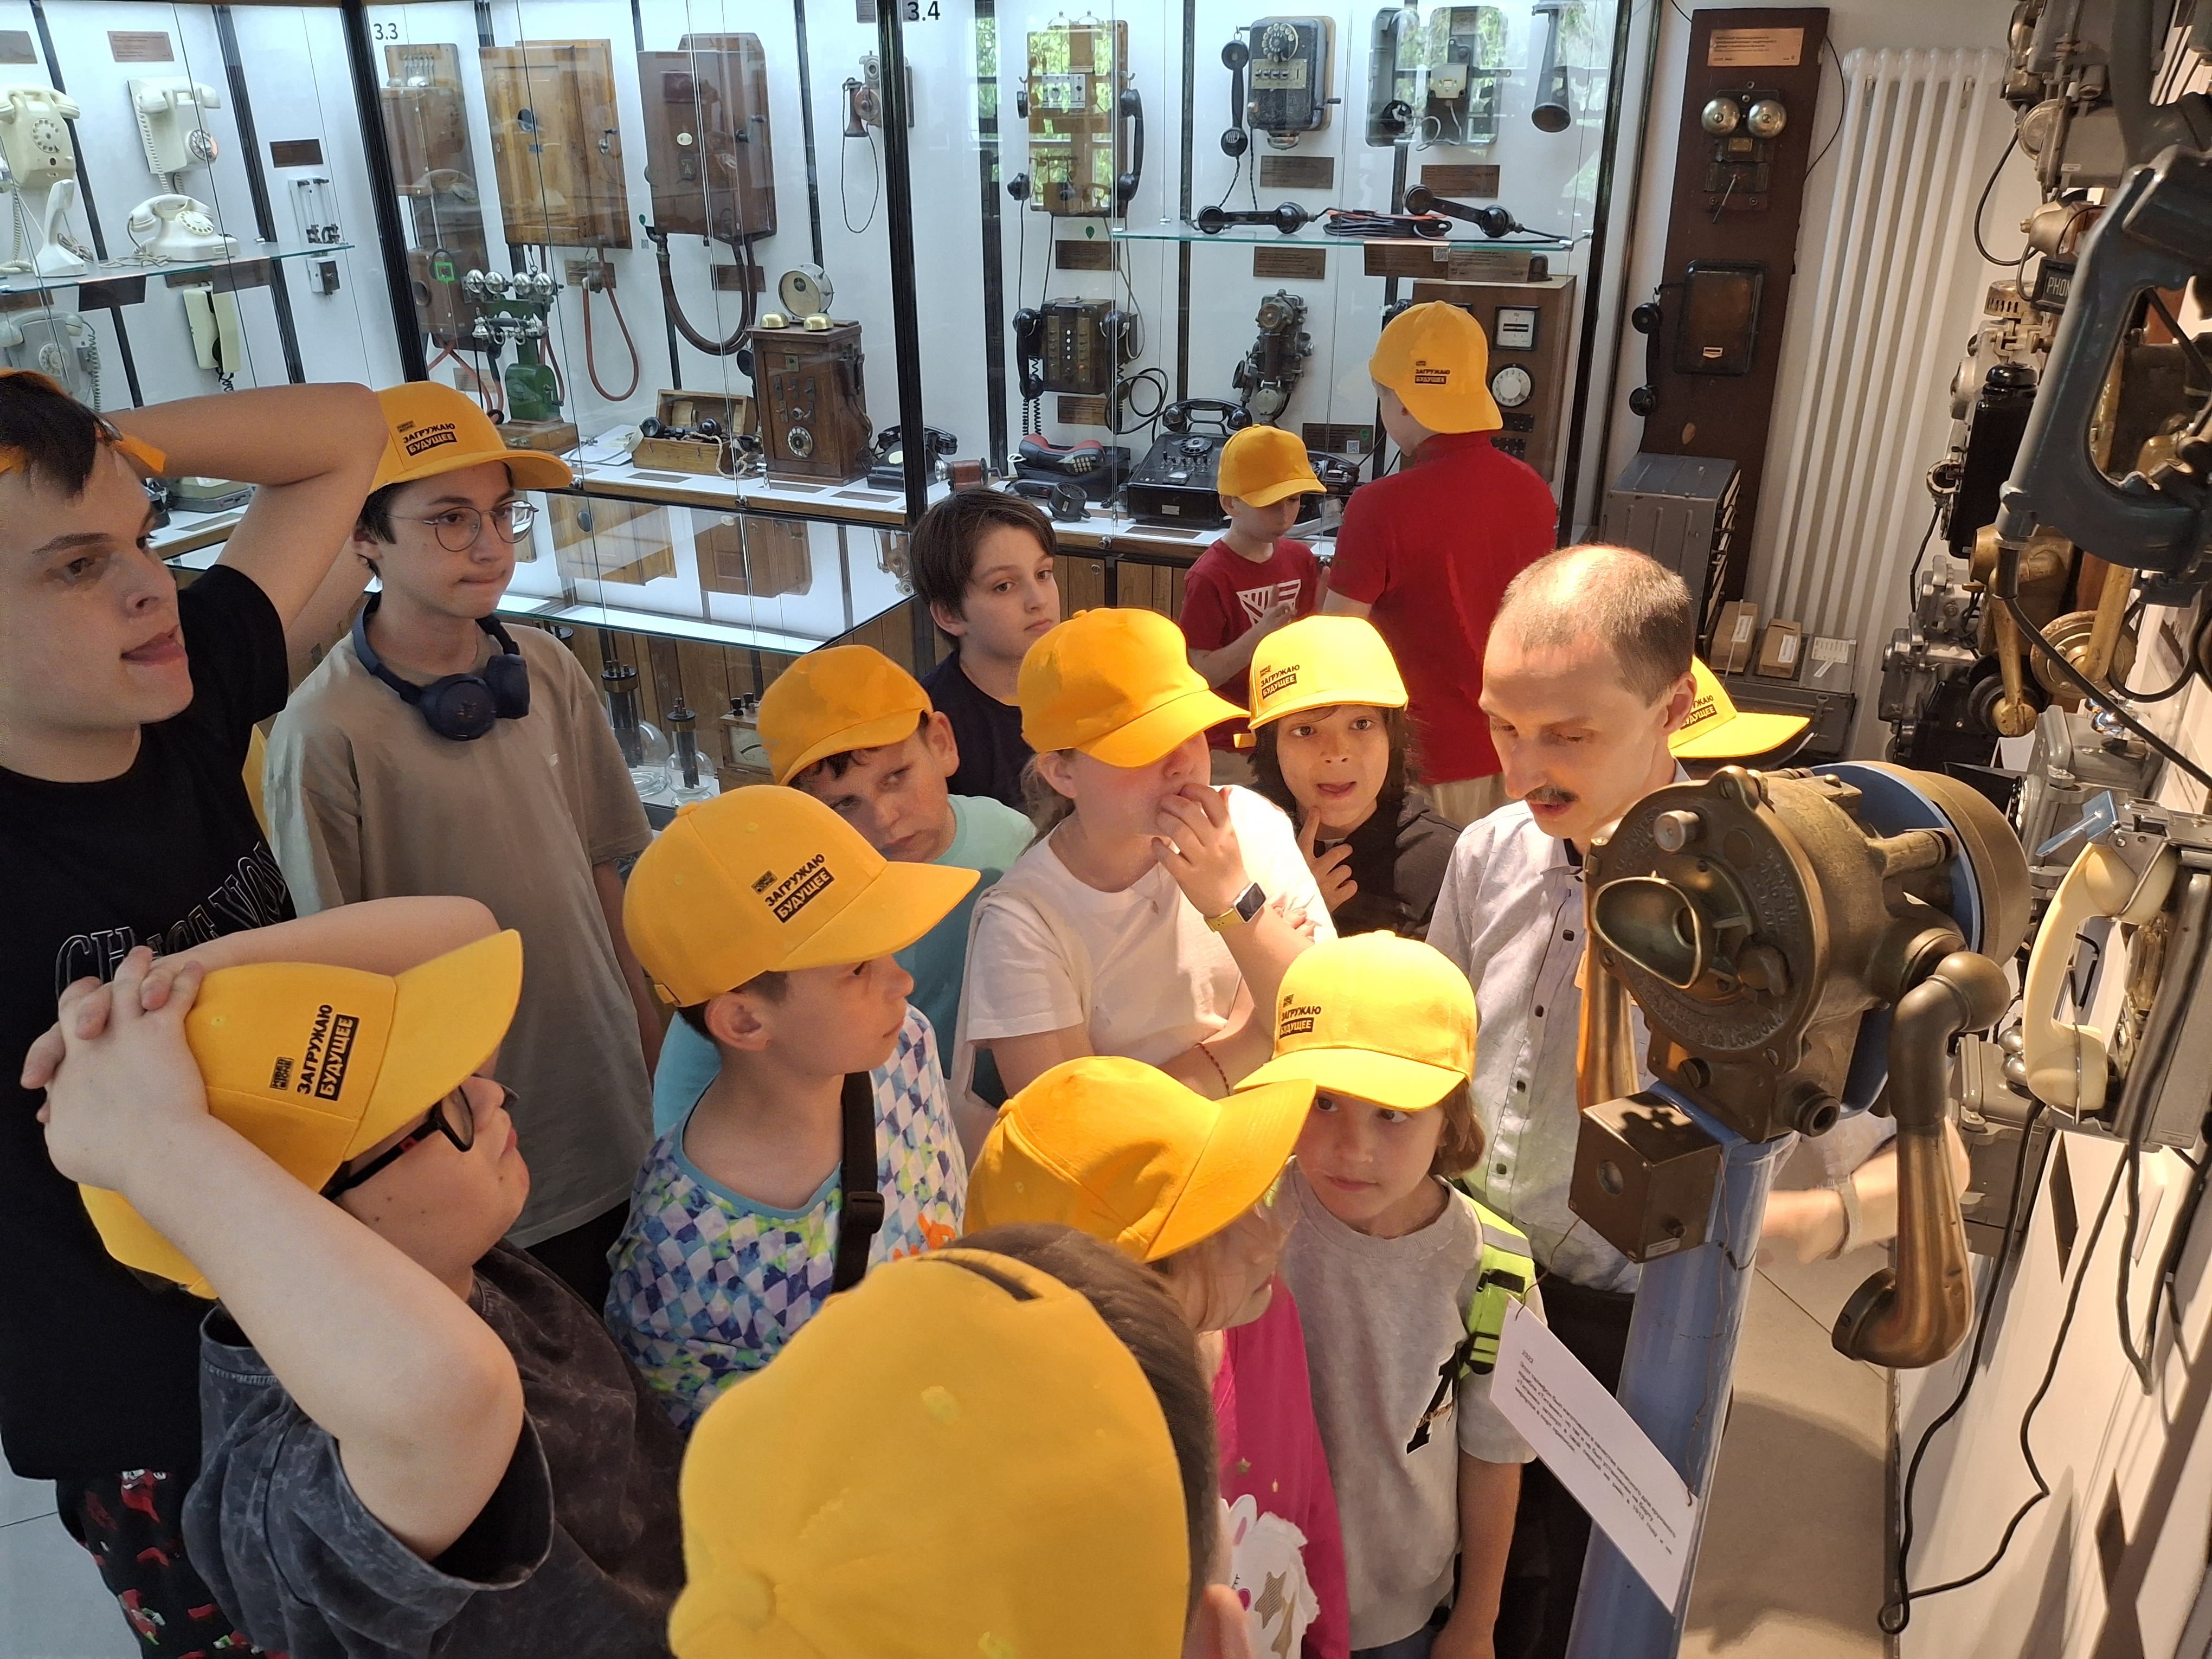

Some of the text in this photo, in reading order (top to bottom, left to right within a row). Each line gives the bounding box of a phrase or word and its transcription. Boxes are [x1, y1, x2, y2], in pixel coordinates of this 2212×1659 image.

[907, 1, 941, 21] 3.4
[374, 23, 398, 40] 3.3
[403, 423, 455, 443] ЗАГРУЖАЮ
[408, 433, 454, 453] БУДУЩЕЕ
[1261, 664, 1300, 687] ЗАГРУЖАЮ
[1263, 675, 1295, 697] БУДУЩЕЕ
[765, 853, 825, 907] ЗАГРУЖАЮ
[776, 871, 831, 918] БУДУЩЕЕ
[1282, 1006, 1321, 1021] ЗАГРУЖАЮ
[297, 1004, 333, 1095] ЗАГРУЖАЮ
[319, 1017, 354, 1096] БУДУЩЕЕ
